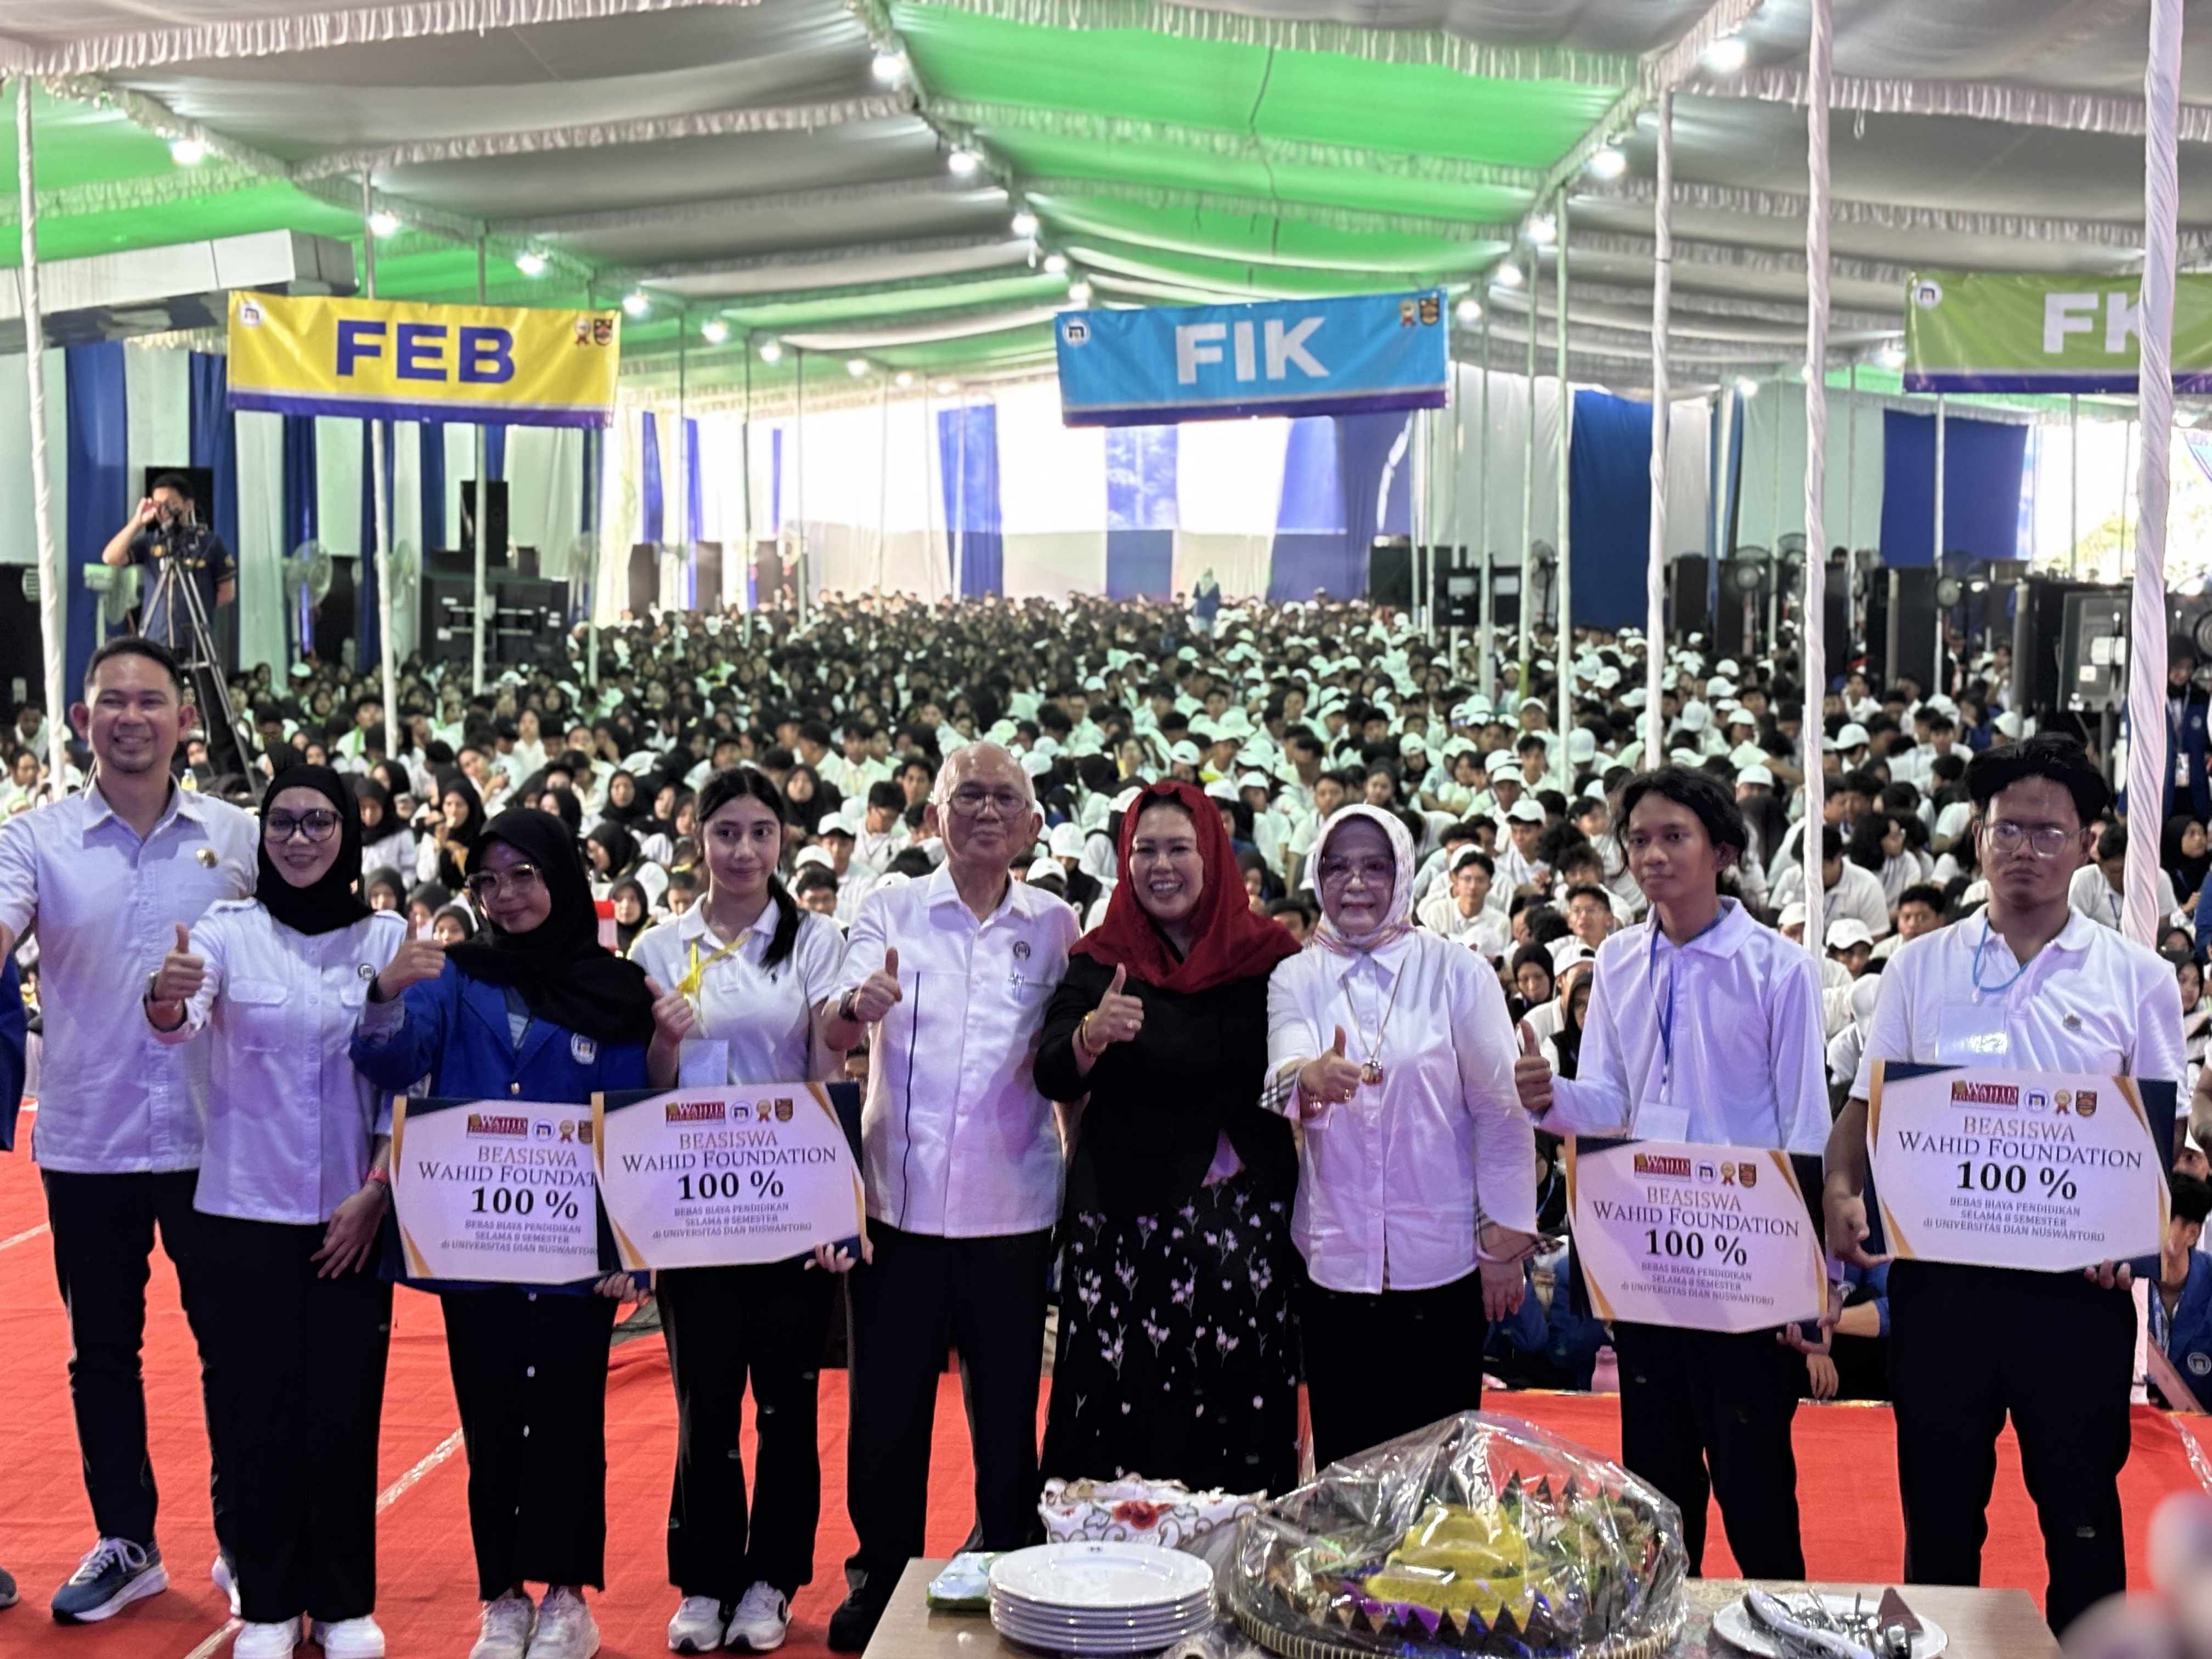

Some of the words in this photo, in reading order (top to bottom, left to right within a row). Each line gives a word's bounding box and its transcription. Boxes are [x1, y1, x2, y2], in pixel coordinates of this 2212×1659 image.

[336, 319, 515, 384] FEB
[1175, 316, 1330, 385] FIK
[680, 1130, 777, 1150] BEASISWA
[1964, 1115, 2075, 1142] BEASISWA
[478, 1146, 577, 1167] BEASISWA
[622, 1154, 695, 1172] WAHID
[703, 1147, 836, 1169] FOUNDATION
[1898, 1131, 1980, 1155] WAHID
[1989, 1138, 2142, 1168] FOUNDATION
[419, 1161, 493, 1181] WAHID
[500, 1165, 595, 1187] FOUNDAT
[678, 1172, 739, 1200] 100
[751, 1169, 784, 1198] %
[1957, 1161, 2026, 1194] 100
[2040, 1166, 2077, 1200] %
[472, 1186, 534, 1215] 100
[546, 1190, 578, 1218] %
[732, 1203, 789, 1214] PENDIDIKAN
[1647, 1186, 1742, 1211] BEASISWA
[2016, 1202, 2080, 1216] PENDIDIKAN
[524, 1223, 582, 1233] PENDIDIKAN
[663, 1227, 721, 1238] UNIVERSITAS
[724, 1226, 746, 1235] DIAN
[748, 1222, 812, 1233] NUSWANTORO
[686, 1216, 722, 1227] SELAMA
[731, 1214, 777, 1224] SEMESTER
[1593, 1201, 1662, 1223] WAHID
[1671, 1208, 1799, 1237] FOUNDATION
[1936, 1218, 2000, 1233] UNIVERSITAS
[2004, 1225, 2028, 1235] DIAN
[2032, 1227, 2105, 1242] NUSWANTORO
[1961, 1210, 2002, 1222] SELAMA
[2013, 1214, 2067, 1227] SEMESTER
[452, 1240, 510, 1251] UNIVERSITAS
[513, 1243, 535, 1253] DIAN
[538, 1245, 598, 1256] NUSWANTOR
[475, 1232, 512, 1240] SELAMA
[522, 1234, 569, 1243] SEMESTER
[1645, 1227, 1703, 1260] 100
[1715, 1234, 1747, 1266] %
[1652, 1274, 1686, 1285] SELAMA
[1696, 1279, 1741, 1290] SEMESTER
[1697, 1268, 1752, 1282] PENDIDIKAN
[1631, 1283, 1686, 1296] UNIVERSITAS
[1689, 1289, 1710, 1299] DIAN
[1712, 1291, 1774, 1305] NUSWANTORO
